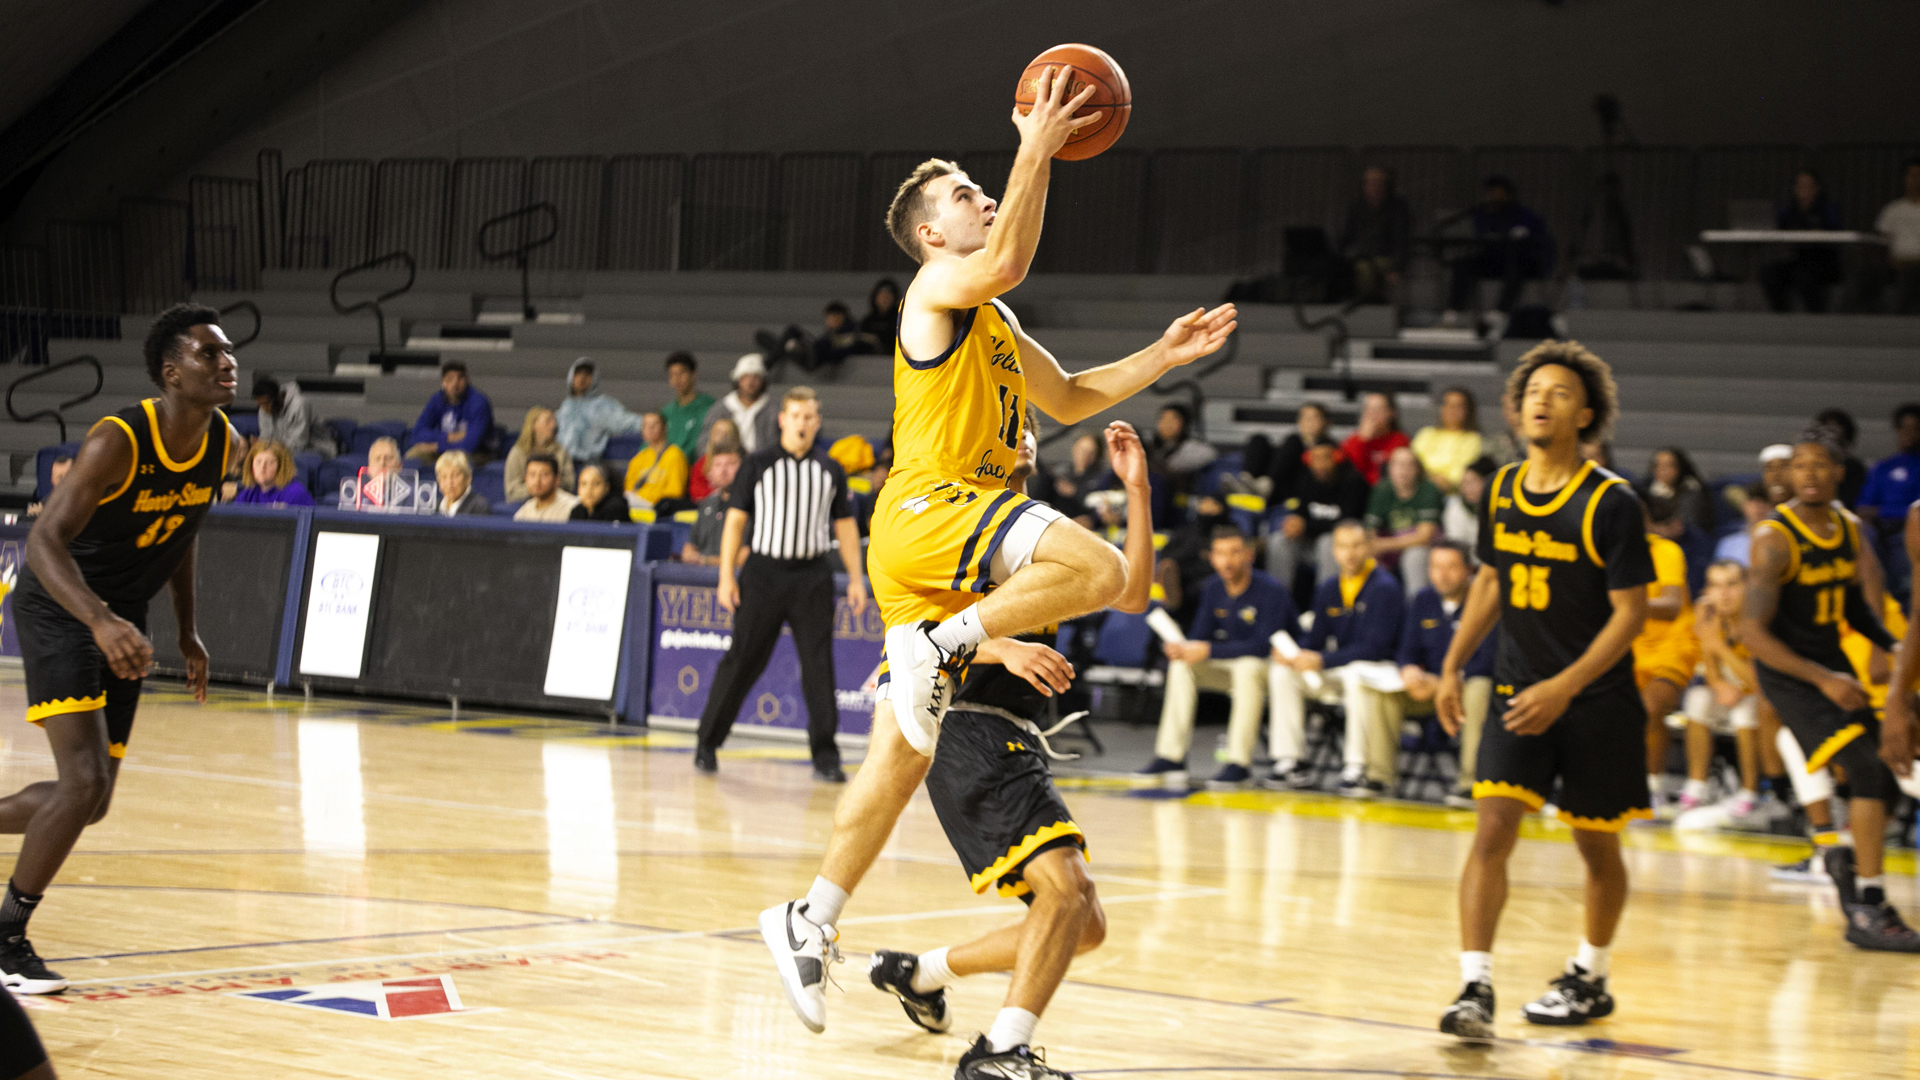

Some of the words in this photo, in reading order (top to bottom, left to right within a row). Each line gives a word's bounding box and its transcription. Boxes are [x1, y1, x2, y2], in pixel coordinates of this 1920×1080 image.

[998, 383, 1020, 450] 11
[1509, 562, 1552, 611] 25
[1814, 585, 1845, 625] 11
